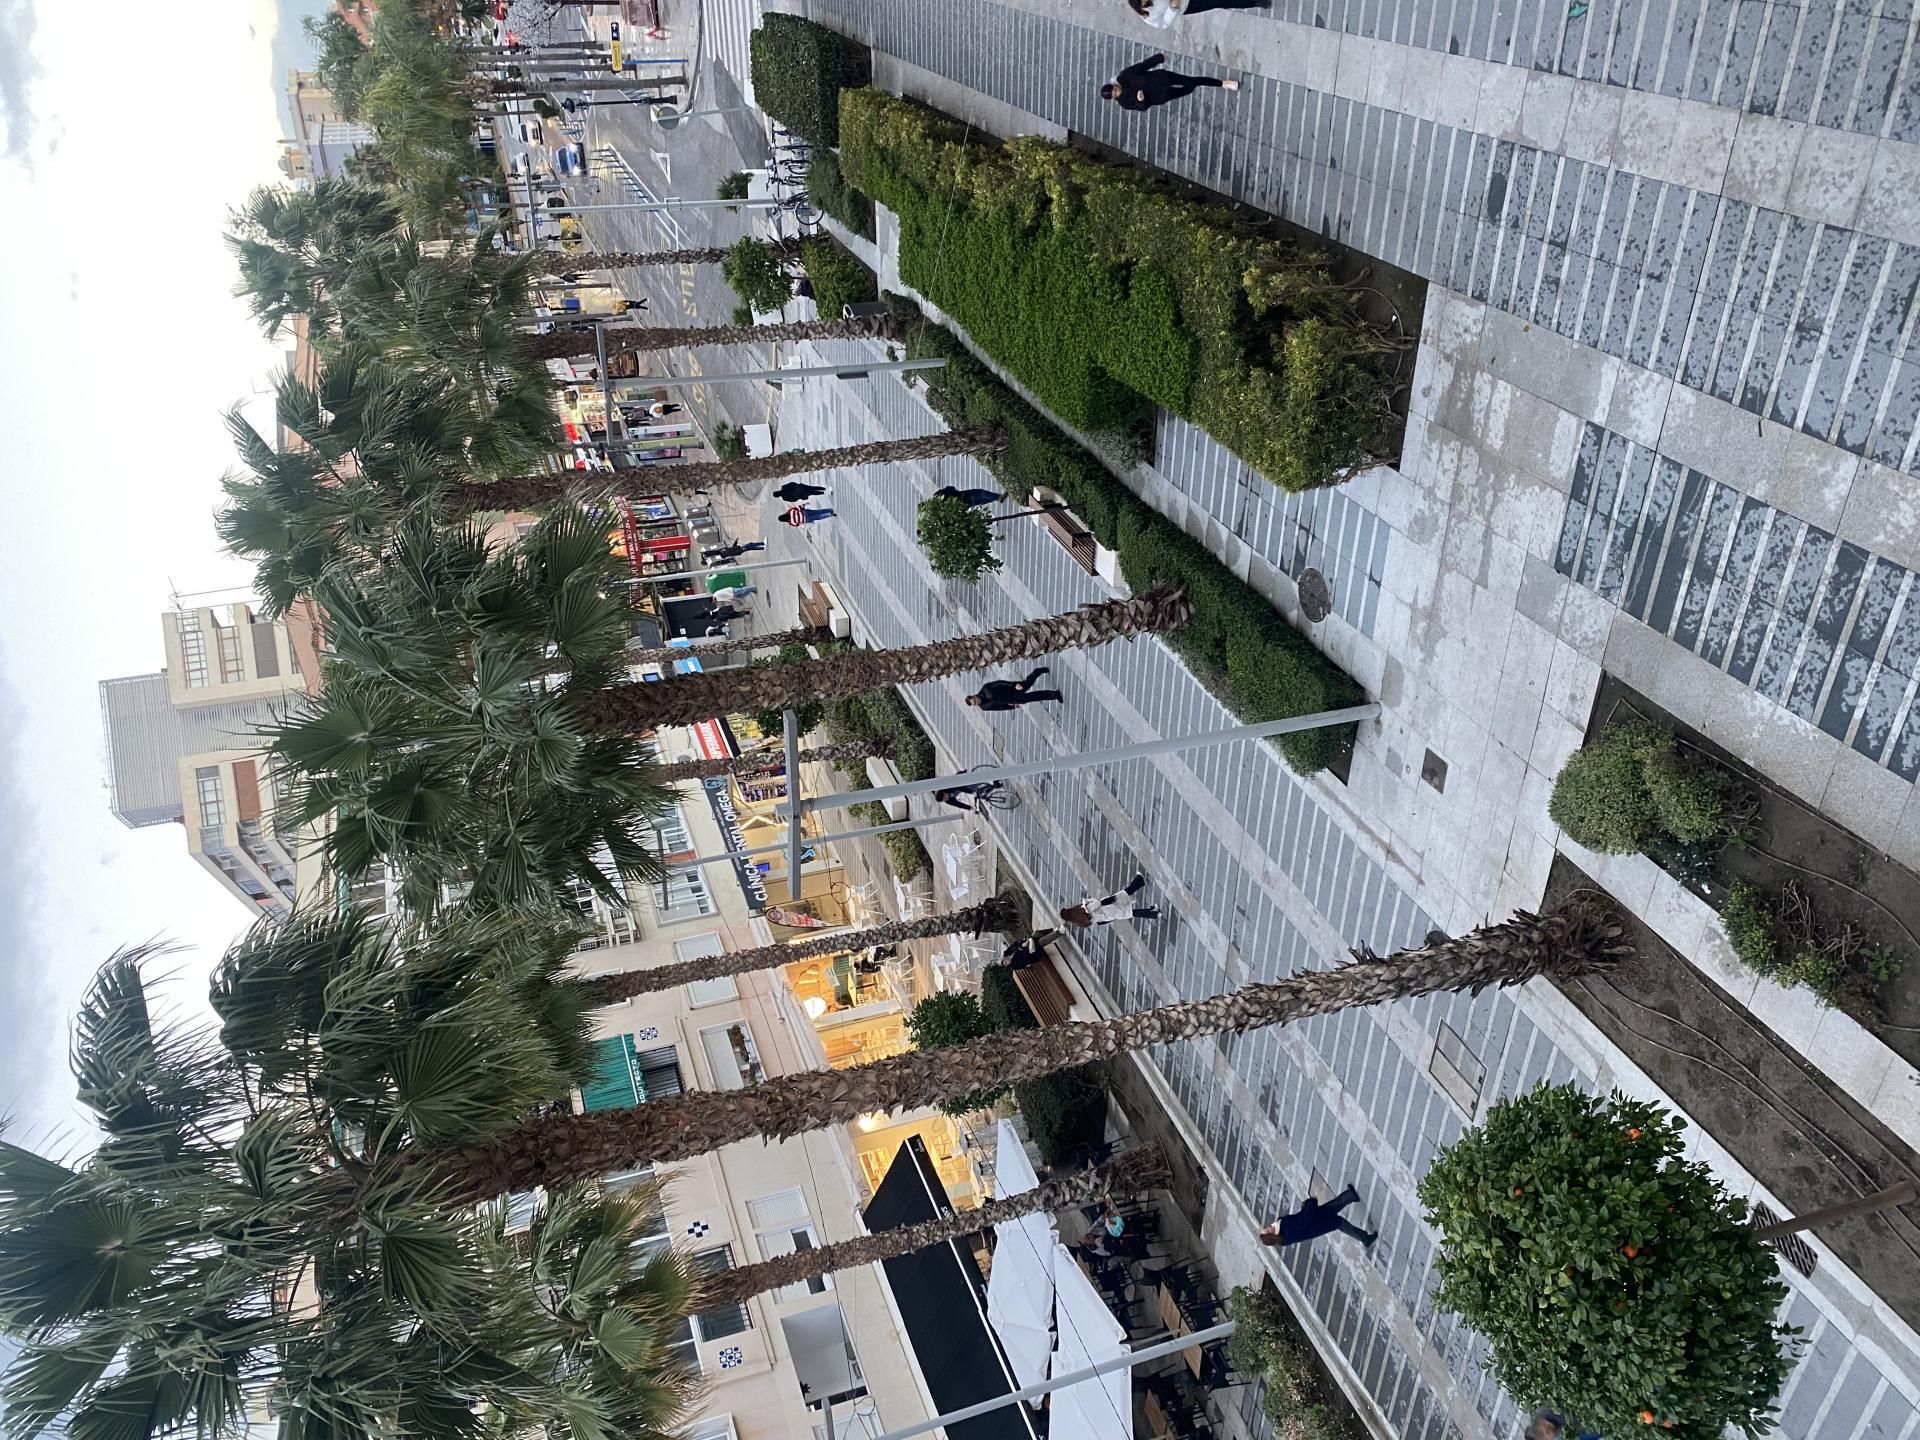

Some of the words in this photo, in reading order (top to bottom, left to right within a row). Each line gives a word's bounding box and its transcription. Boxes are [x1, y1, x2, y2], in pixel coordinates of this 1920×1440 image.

[698, 722, 723, 759] SUPERMARKE
[715, 789, 738, 822] OMEGA
[743, 863, 769, 902] CLÍNICA
[631, 1059, 646, 1104] RQUITECTO
